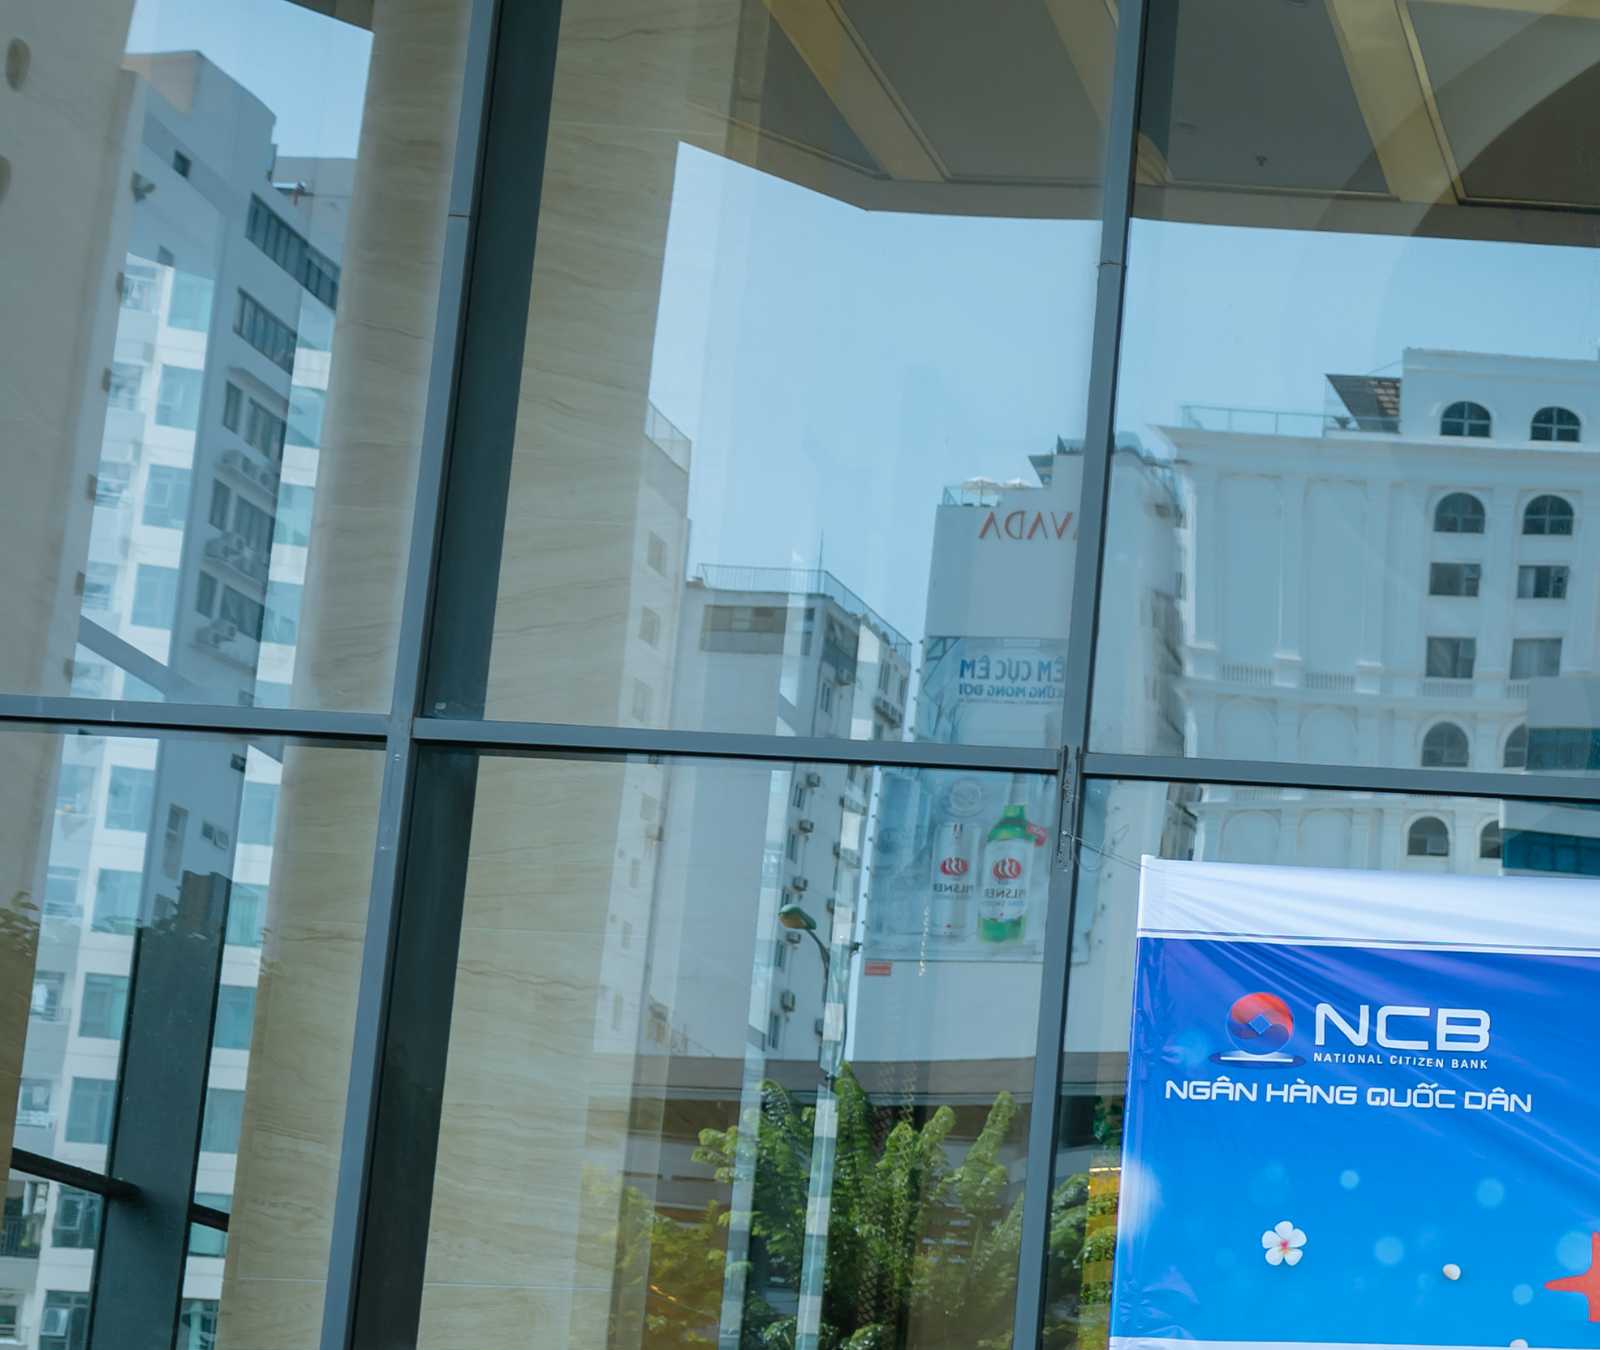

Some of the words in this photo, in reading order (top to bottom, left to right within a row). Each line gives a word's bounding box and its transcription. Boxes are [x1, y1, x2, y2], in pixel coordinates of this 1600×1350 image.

[1314, 1003, 1490, 1053] NCB
[1313, 1052, 1383, 1065] NATIONAL
[1390, 1055, 1444, 1069] CITIZEN
[1451, 1057, 1489, 1070] BANK
[1165, 1076, 1257, 1102] NGÂN
[1266, 1078, 1357, 1105] HÀNG
[1366, 1082, 1456, 1110] QUỐC
[1464, 1086, 1533, 1113] DÂN
